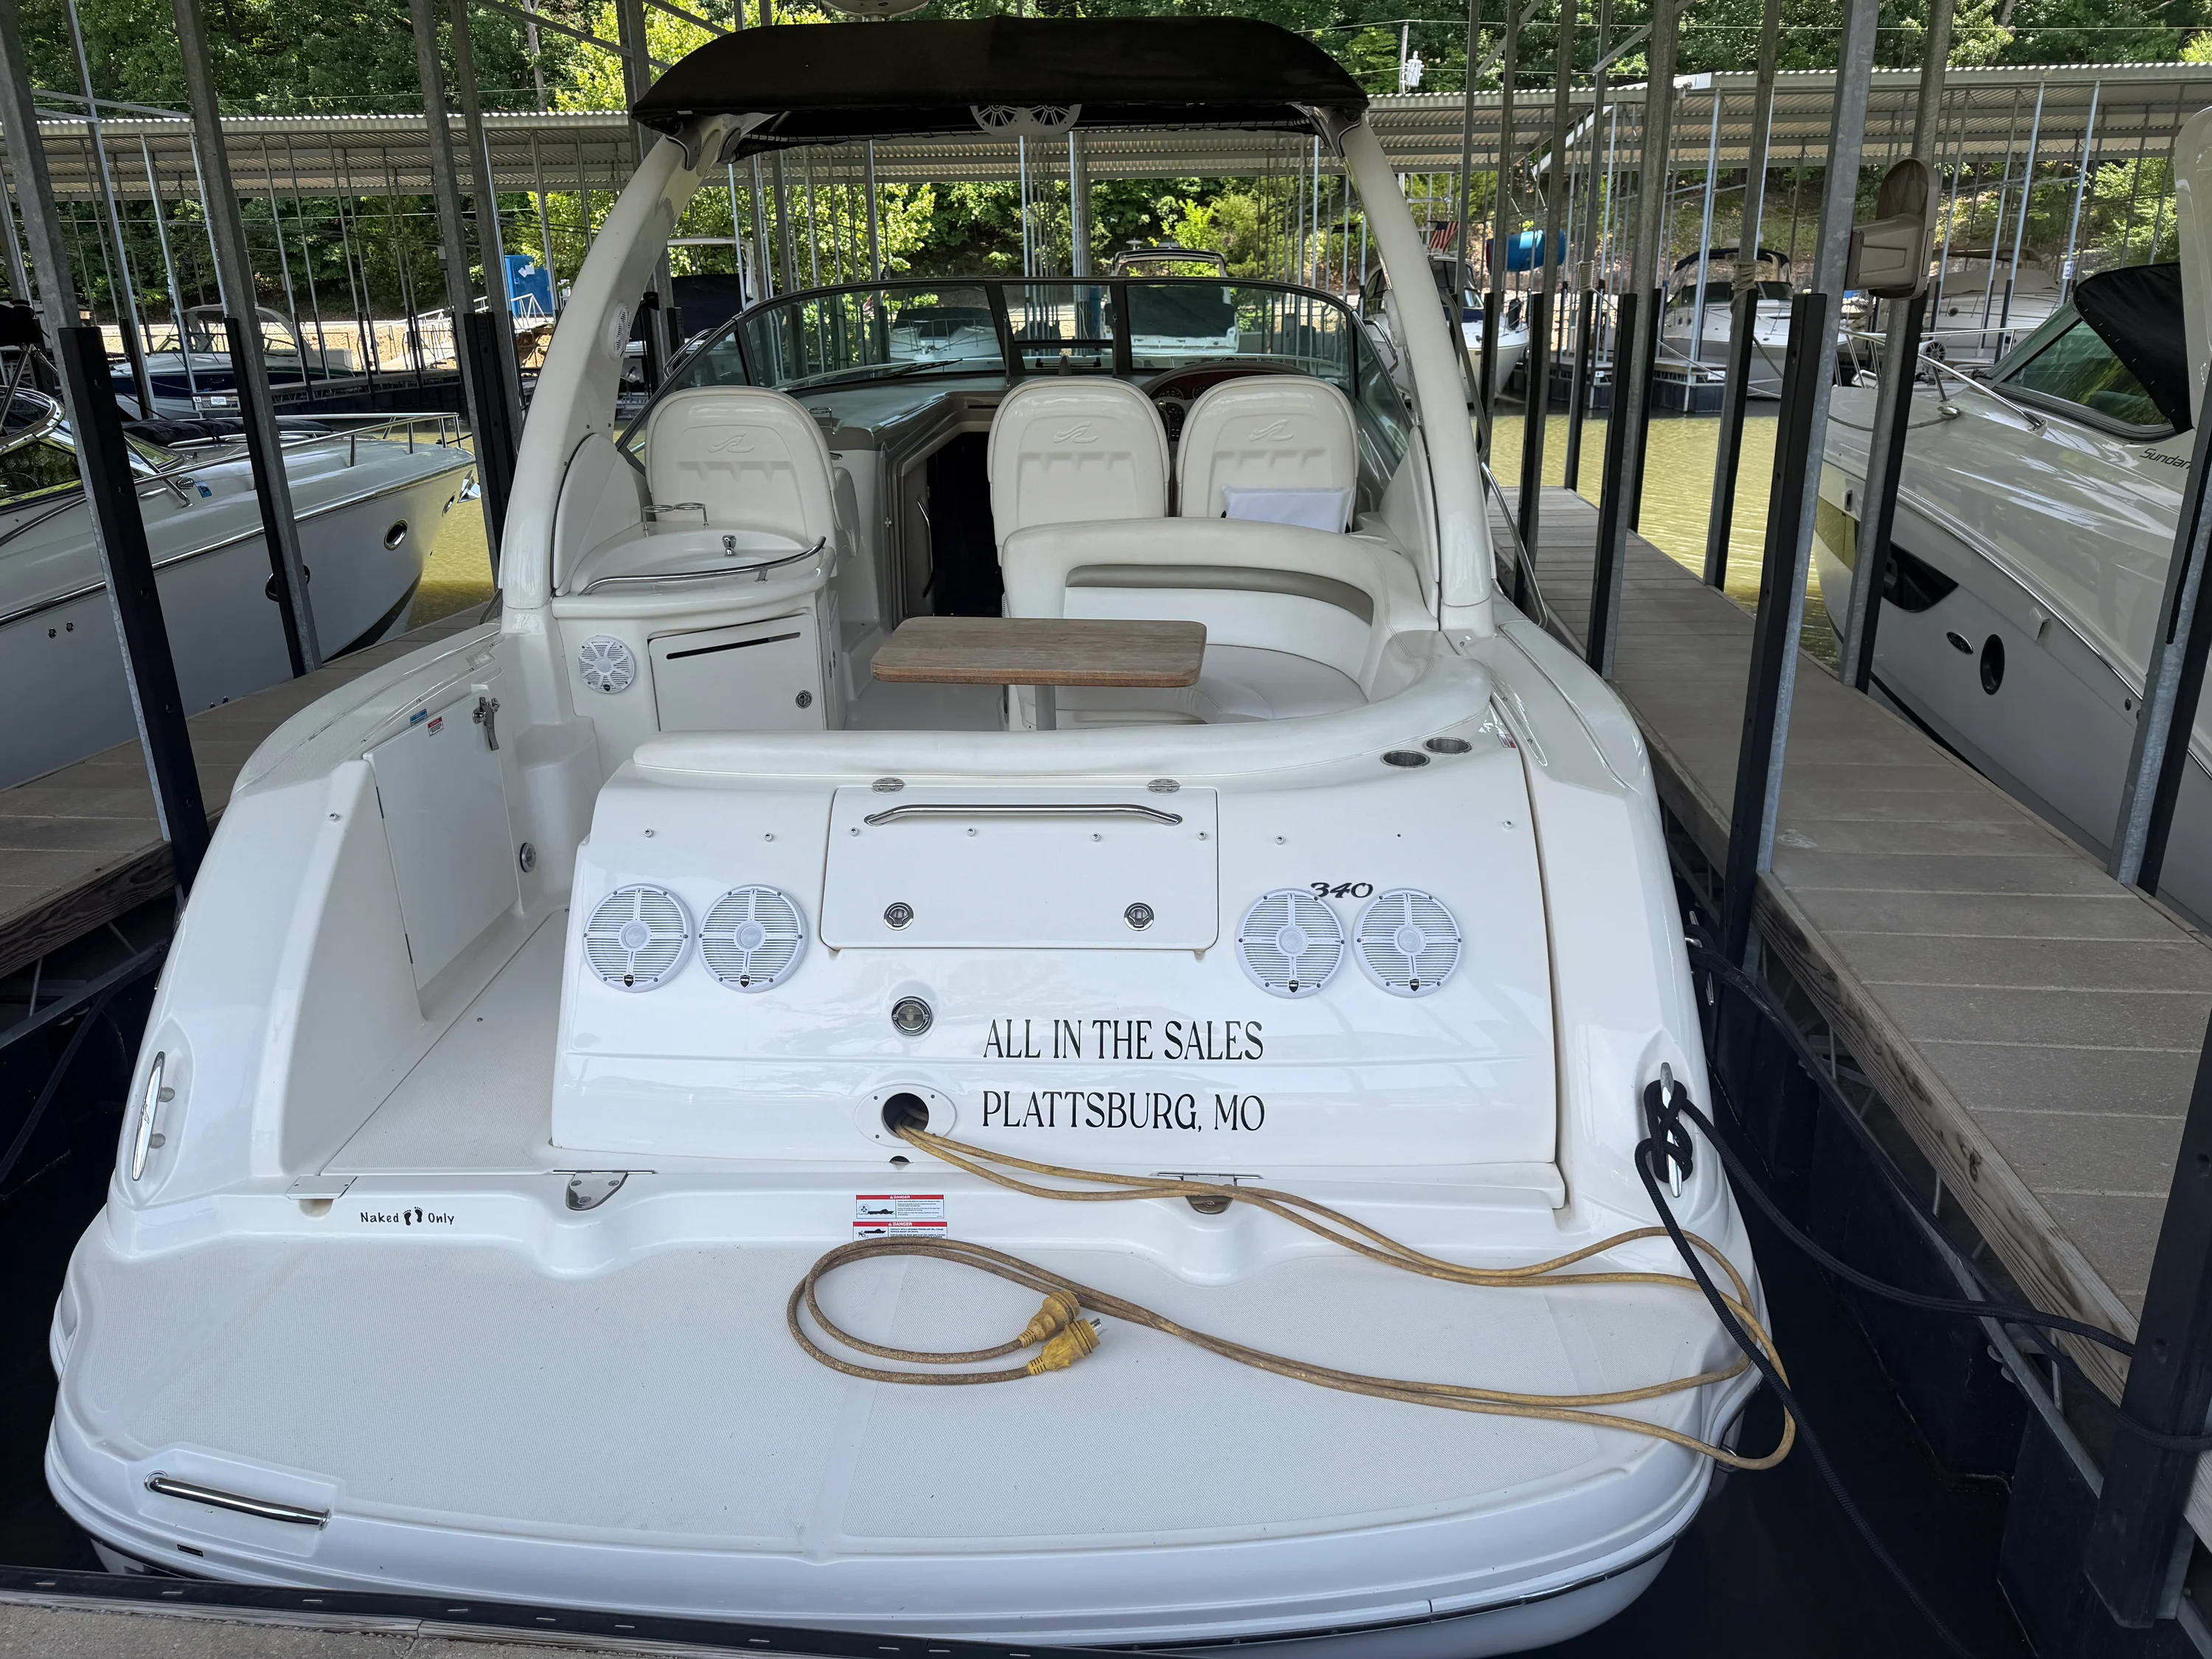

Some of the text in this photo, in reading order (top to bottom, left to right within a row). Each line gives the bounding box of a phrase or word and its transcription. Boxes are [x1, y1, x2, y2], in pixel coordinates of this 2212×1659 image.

[1310, 882, 1373, 898] 340
[983, 1019, 1263, 1060] ALL IN THE SALES
[983, 1091, 1265, 1133] PLATTSBURG, MO
[361, 1212, 454, 1225] Naked Only
